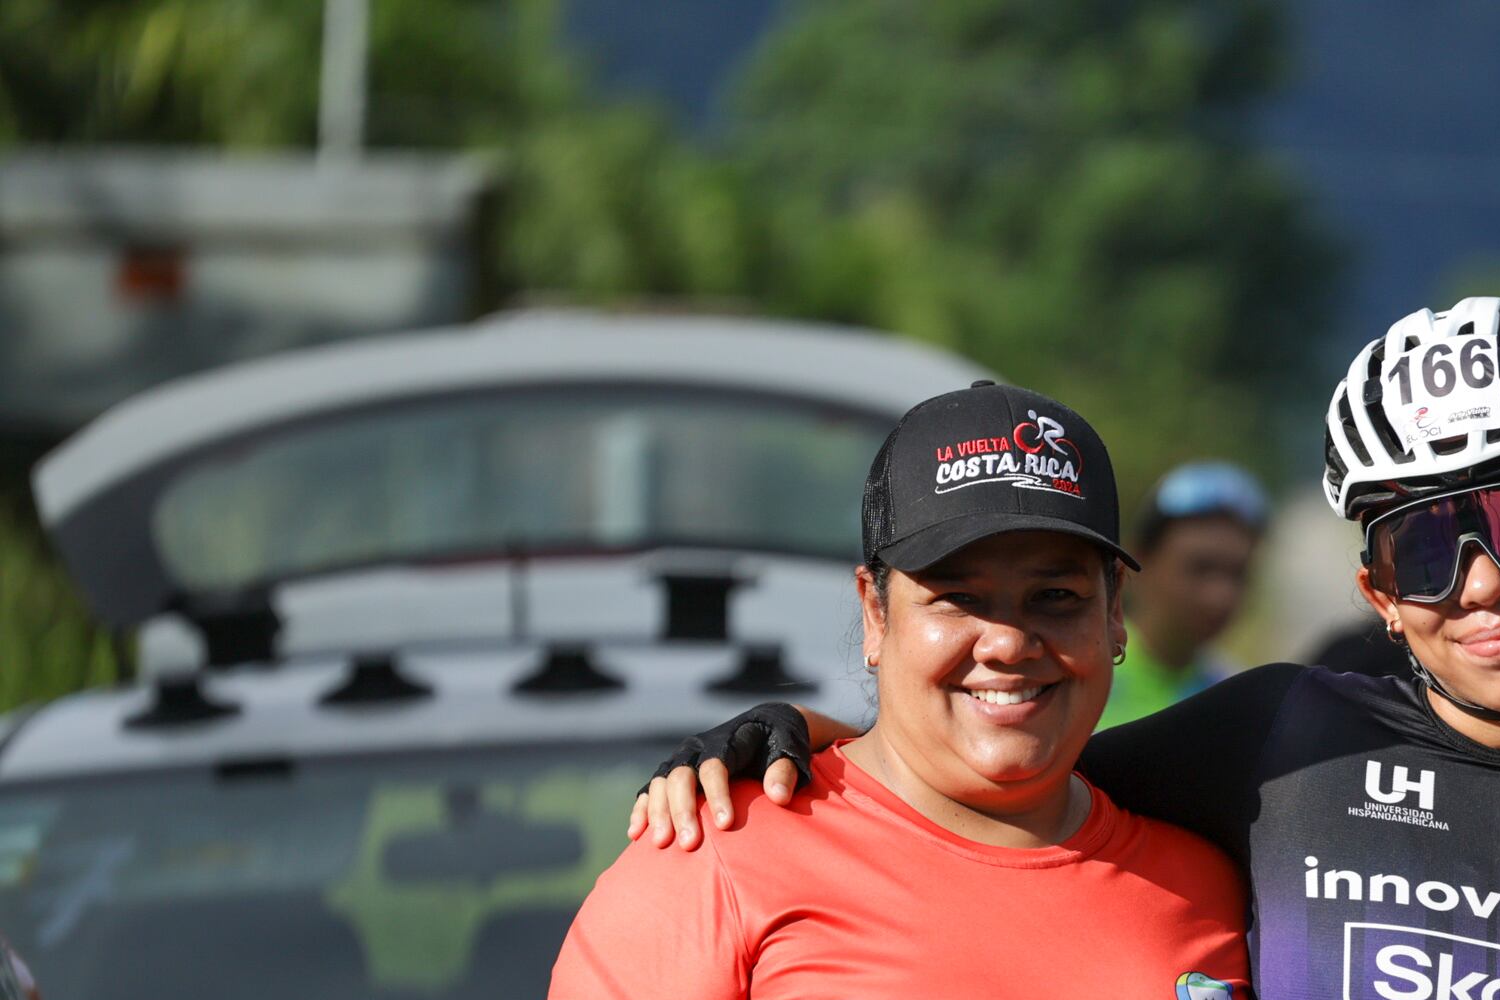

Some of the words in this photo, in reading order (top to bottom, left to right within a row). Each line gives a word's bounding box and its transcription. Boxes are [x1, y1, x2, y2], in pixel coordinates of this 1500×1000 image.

[1388, 338, 1494, 405] 166
[937, 446, 953, 461] LA
[957, 437, 1009, 457] VUELTA
[936, 452, 1020, 484] COSTA
[1024, 453, 1079, 482] RICA
[1053, 478, 1081, 496] 2024
[1365, 760, 1435, 810] UH
[1348, 806, 1450, 831] HISPANOAMERICANA
[1364, 801, 1434, 820] UNIVERSIDAD
